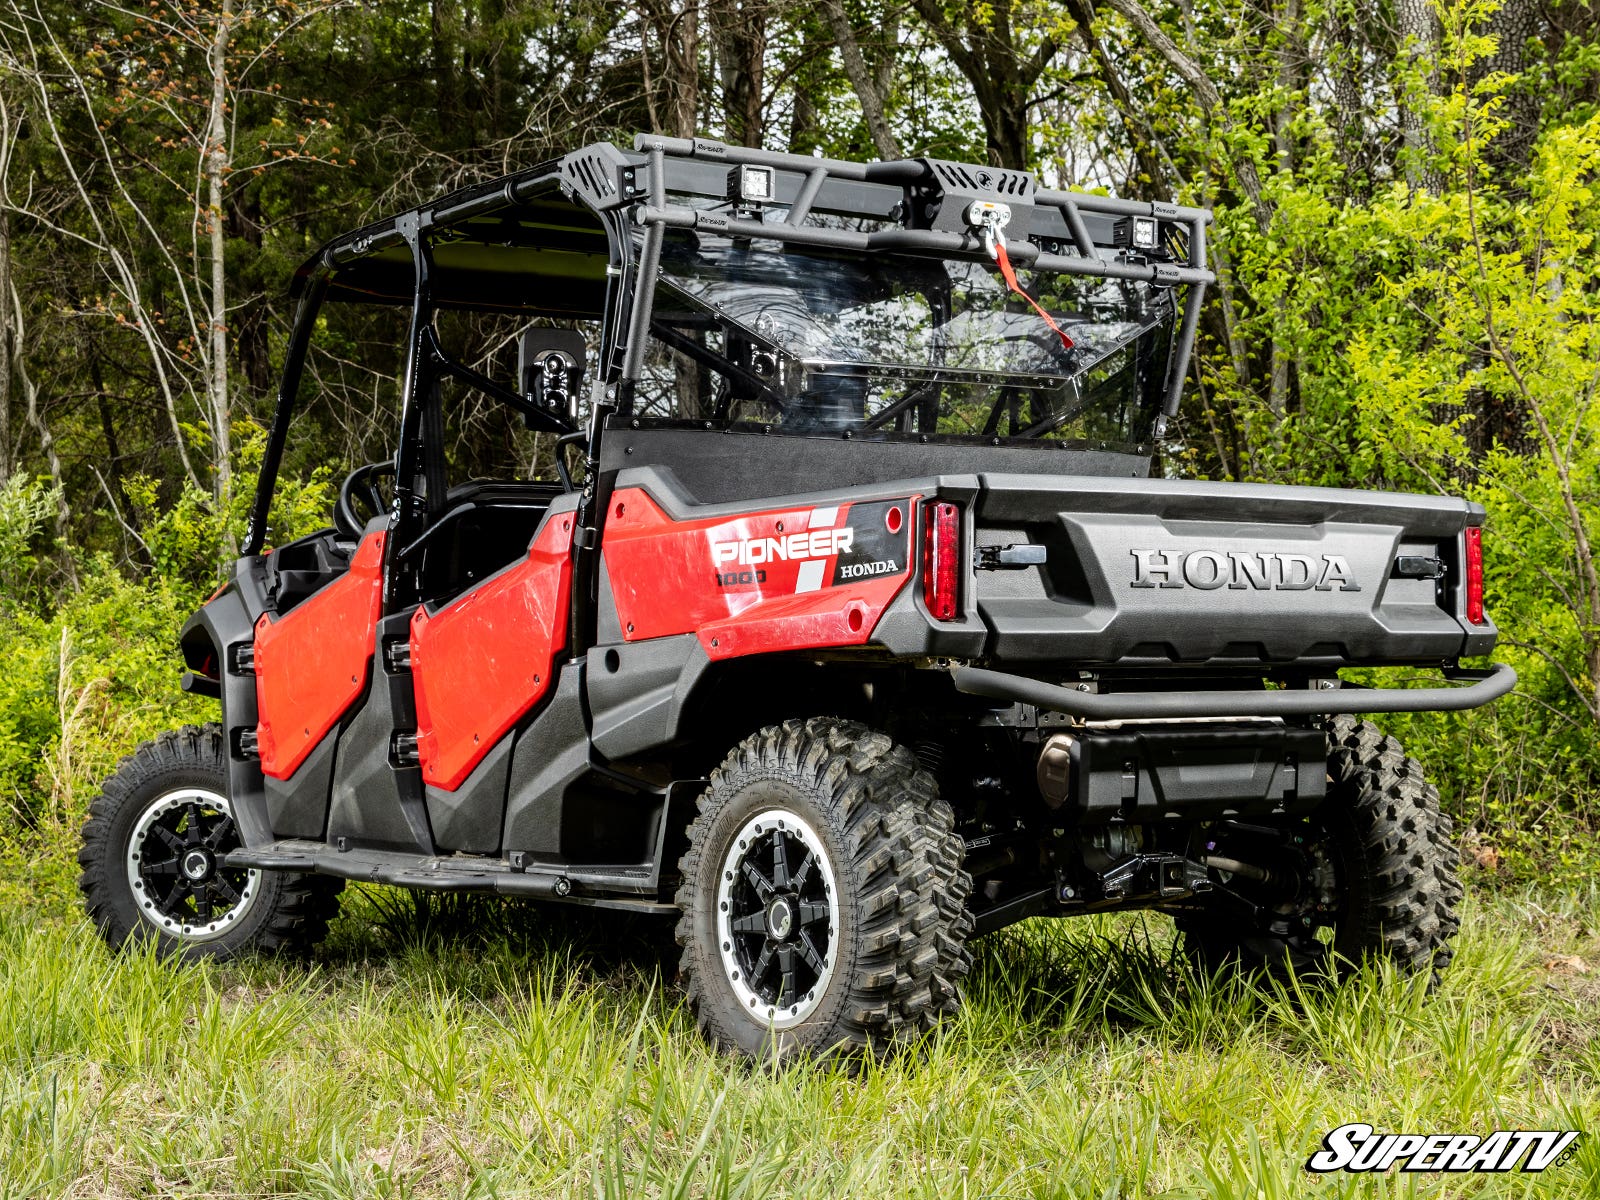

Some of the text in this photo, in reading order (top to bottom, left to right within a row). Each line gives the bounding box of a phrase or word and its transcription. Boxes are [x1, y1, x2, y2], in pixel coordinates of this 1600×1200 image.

[714, 527, 853, 567] PIONEER
[715, 570, 766, 587] 1000
[840, 560, 898, 579] HONDA
[1130, 549, 1361, 591] HONDA
